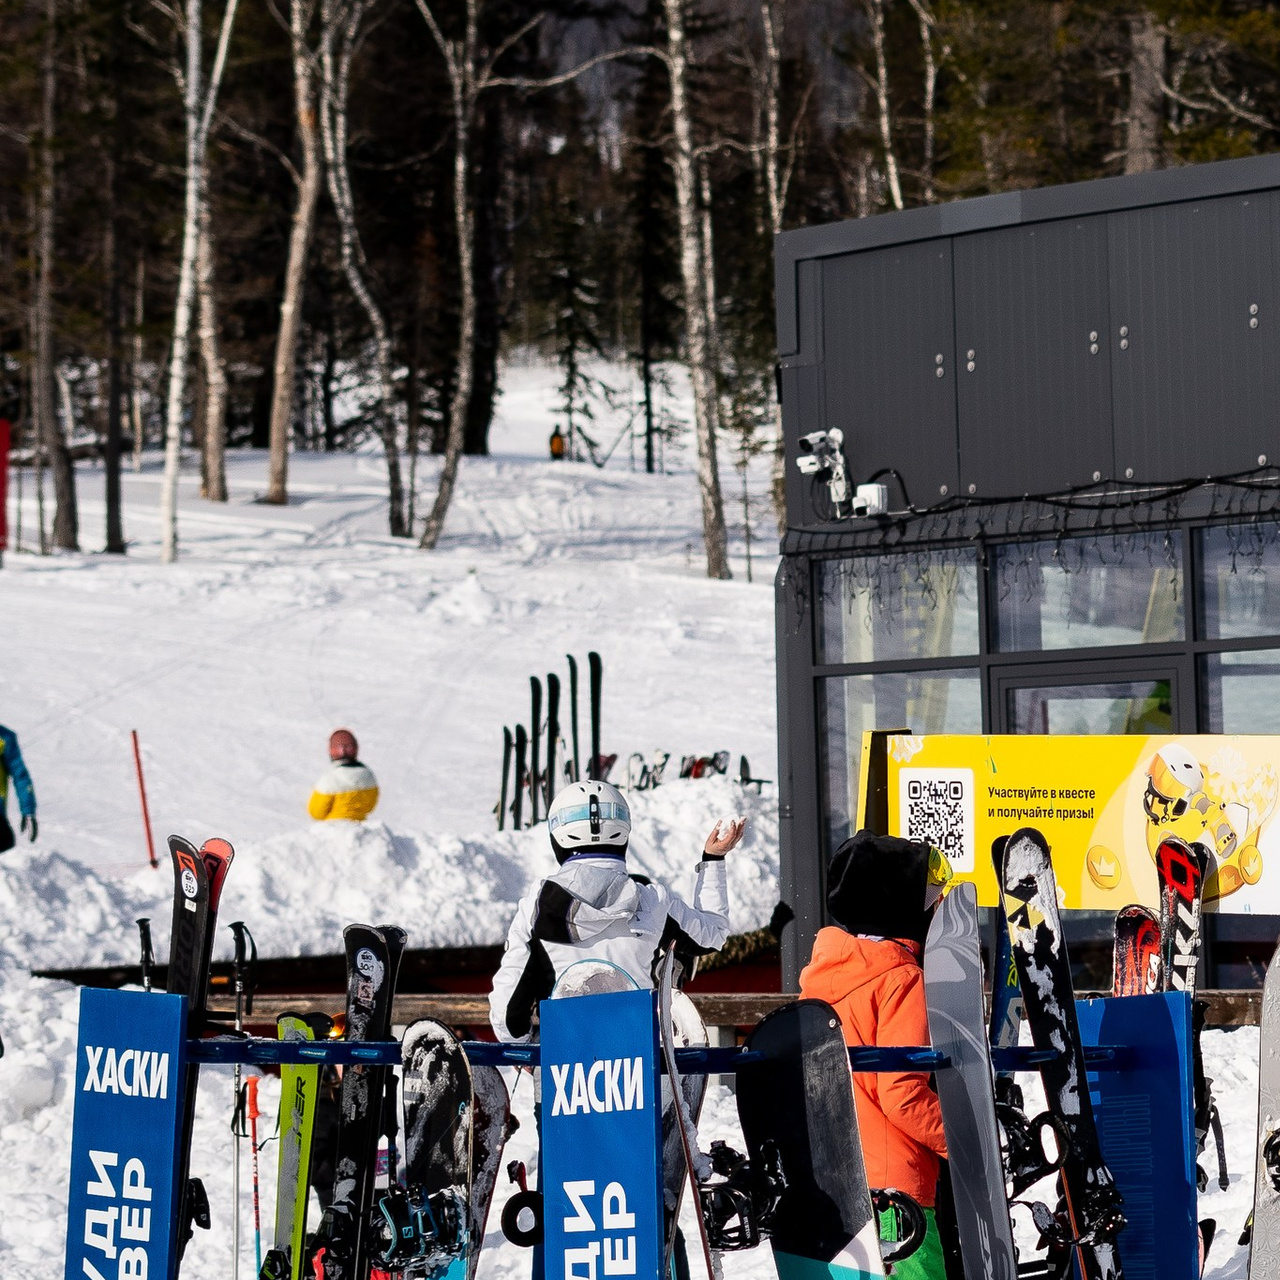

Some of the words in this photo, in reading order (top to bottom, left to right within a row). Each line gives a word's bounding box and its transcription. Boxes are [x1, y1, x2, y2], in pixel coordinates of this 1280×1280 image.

[988, 786, 1049, 801] Участвуйте
[1050, 789, 1057, 799] в
[1058, 789, 1096, 799] квесте
[988, 808, 995, 818] и
[997, 806, 1054, 821] получайте
[1056, 808, 1094, 821] призы!
[83, 1046, 169, 1099] ХАСКИ
[551, 1057, 643, 1116] ХАСКИ
[1102, 1093, 1155, 1176] ЗДОРОВЬЮ
